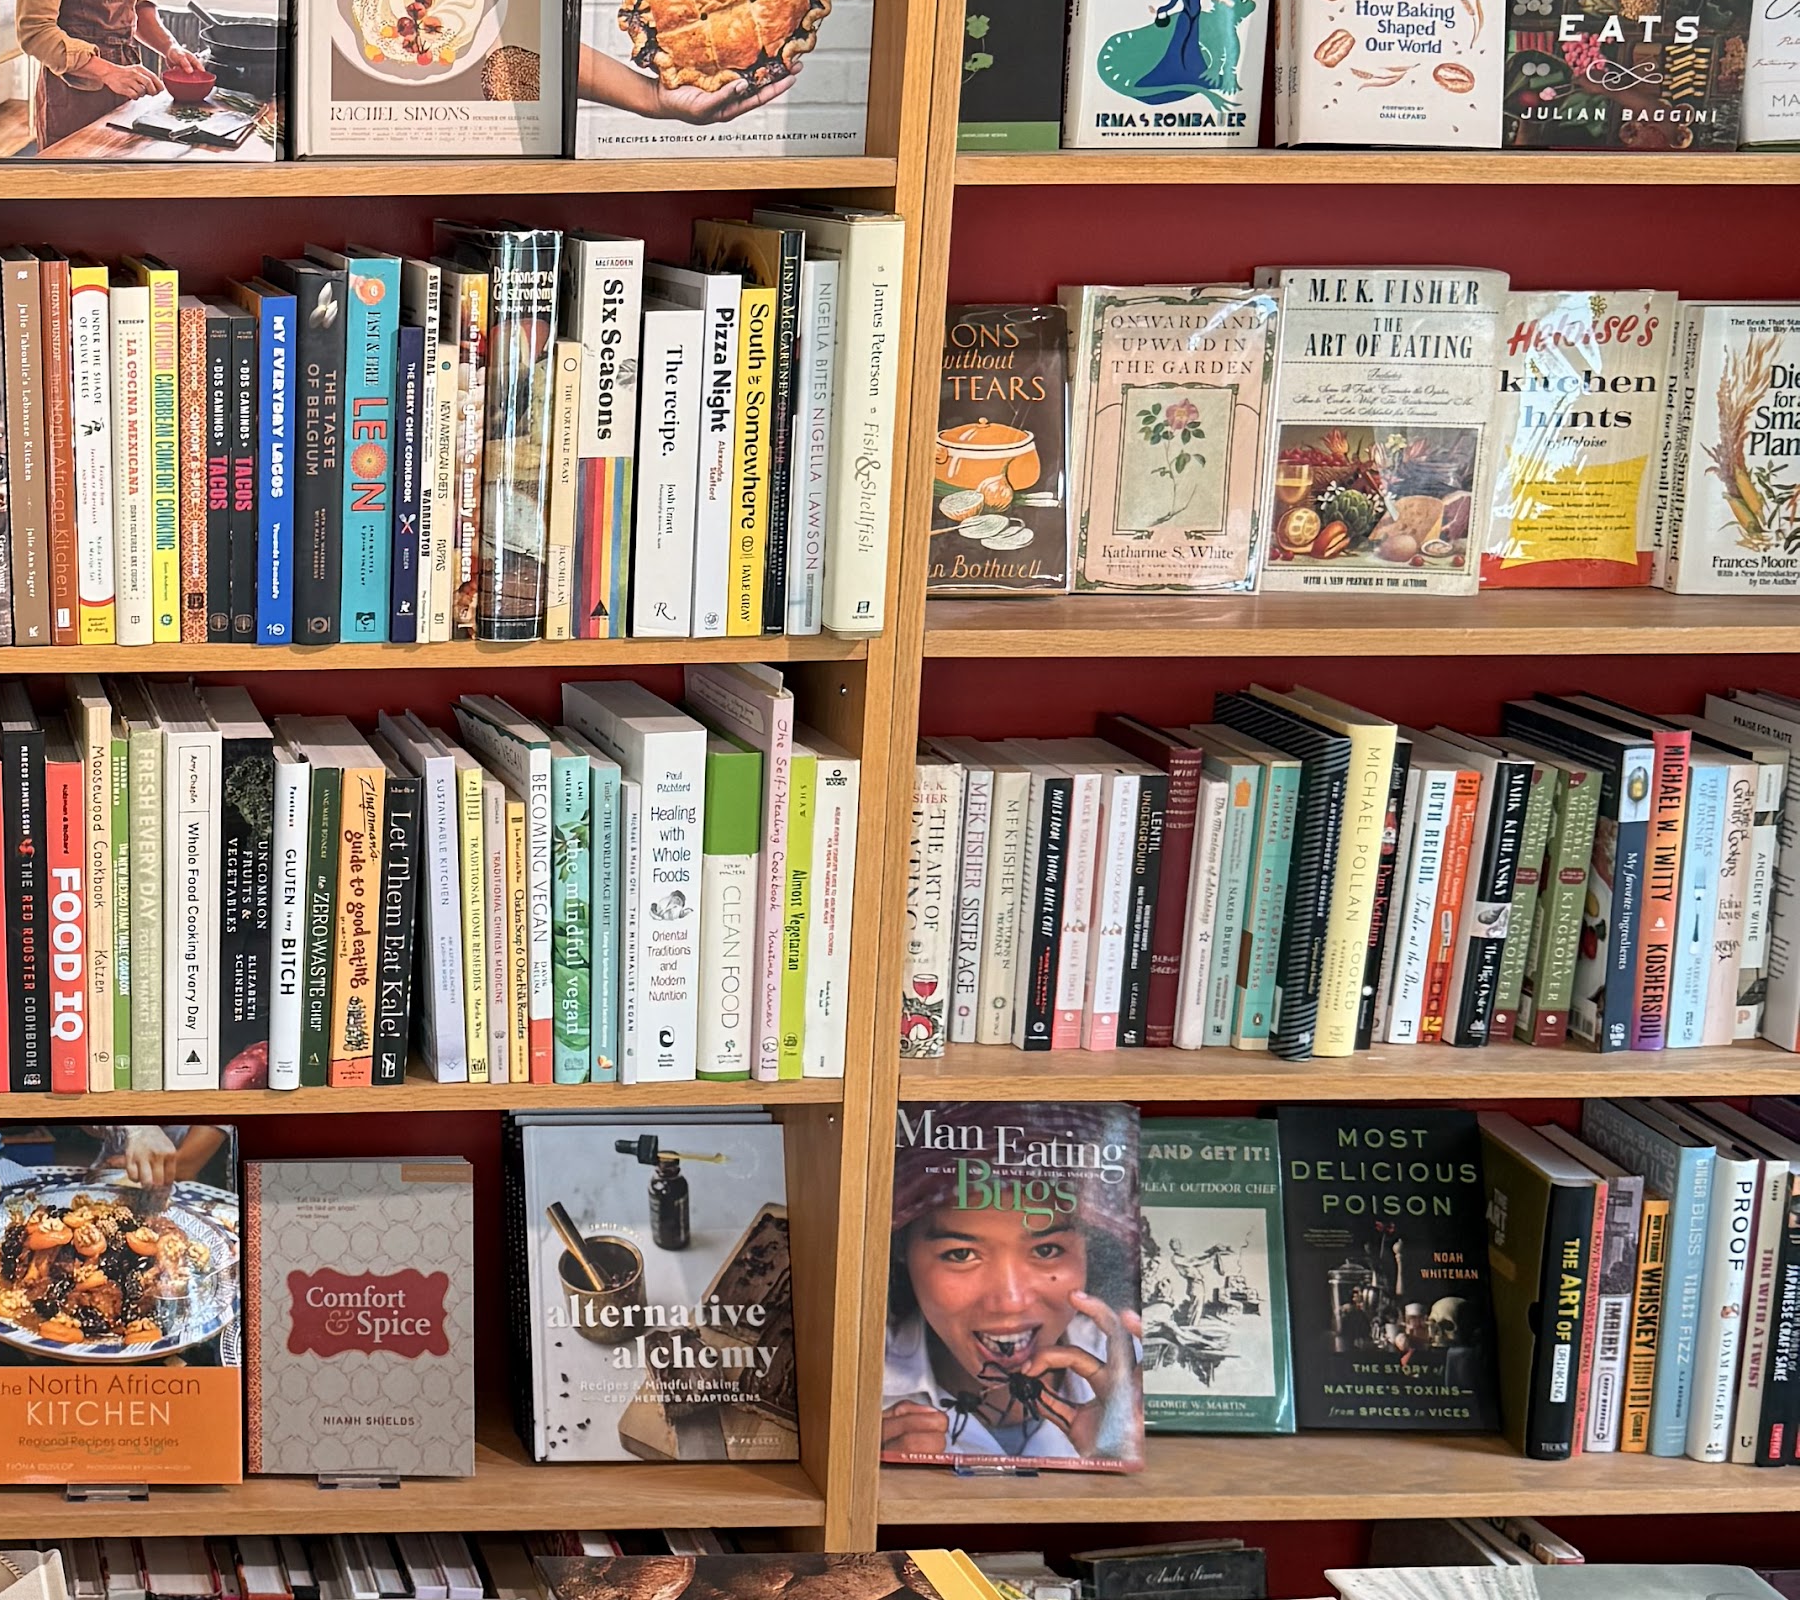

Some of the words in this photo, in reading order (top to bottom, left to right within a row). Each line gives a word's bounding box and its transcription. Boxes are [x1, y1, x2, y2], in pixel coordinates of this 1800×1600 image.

[1556, 15, 1700, 45] EATS
[329, 105, 397, 123] RACHEL
[403, 105, 470, 123] SIMONS
[1520, 105, 1612, 125] JULIAN
[1621, 107, 1718, 124] BAGGINI
[602, 279, 624, 324] Six
[713, 307, 735, 365] Pizza
[1303, 333, 1347, 358] ART
[1355, 333, 1383, 358] OF
[1389, 334, 1474, 360] EATING
[665, 344, 684, 384] The
[597, 329, 622, 441] Seasons
[706, 369, 732, 434] Night
[658, 390, 680, 457] recipe.
[1356, 746, 1382, 836] MICHAEL
[1346, 844, 1369, 922] POLLAN
[51, 867, 85, 982] FOOD
[722, 885, 742, 959] CLEAN
[51, 990, 84, 1042] IQ
[721, 966, 741, 1029] FOOD
[895, 1109, 985, 1155] Man
[1001, 1125, 1129, 1183] Eating
[1337, 1128, 1427, 1151] MOST
[1290, 1158, 1478, 1186] DELICIOUS
[1321, 1193, 1453, 1216] POISON
[305, 1287, 406, 1310] Comfort
[546, 1294, 767, 1328] alternative
[325, 1310, 352, 1336] &
[356, 1311, 431, 1344] Spice
[611, 1335, 779, 1376] alchemy
[28, 1375, 100, 1395] North
[108, 1375, 201, 1395] African
[26, 1400, 171, 1427] KITCHEN
